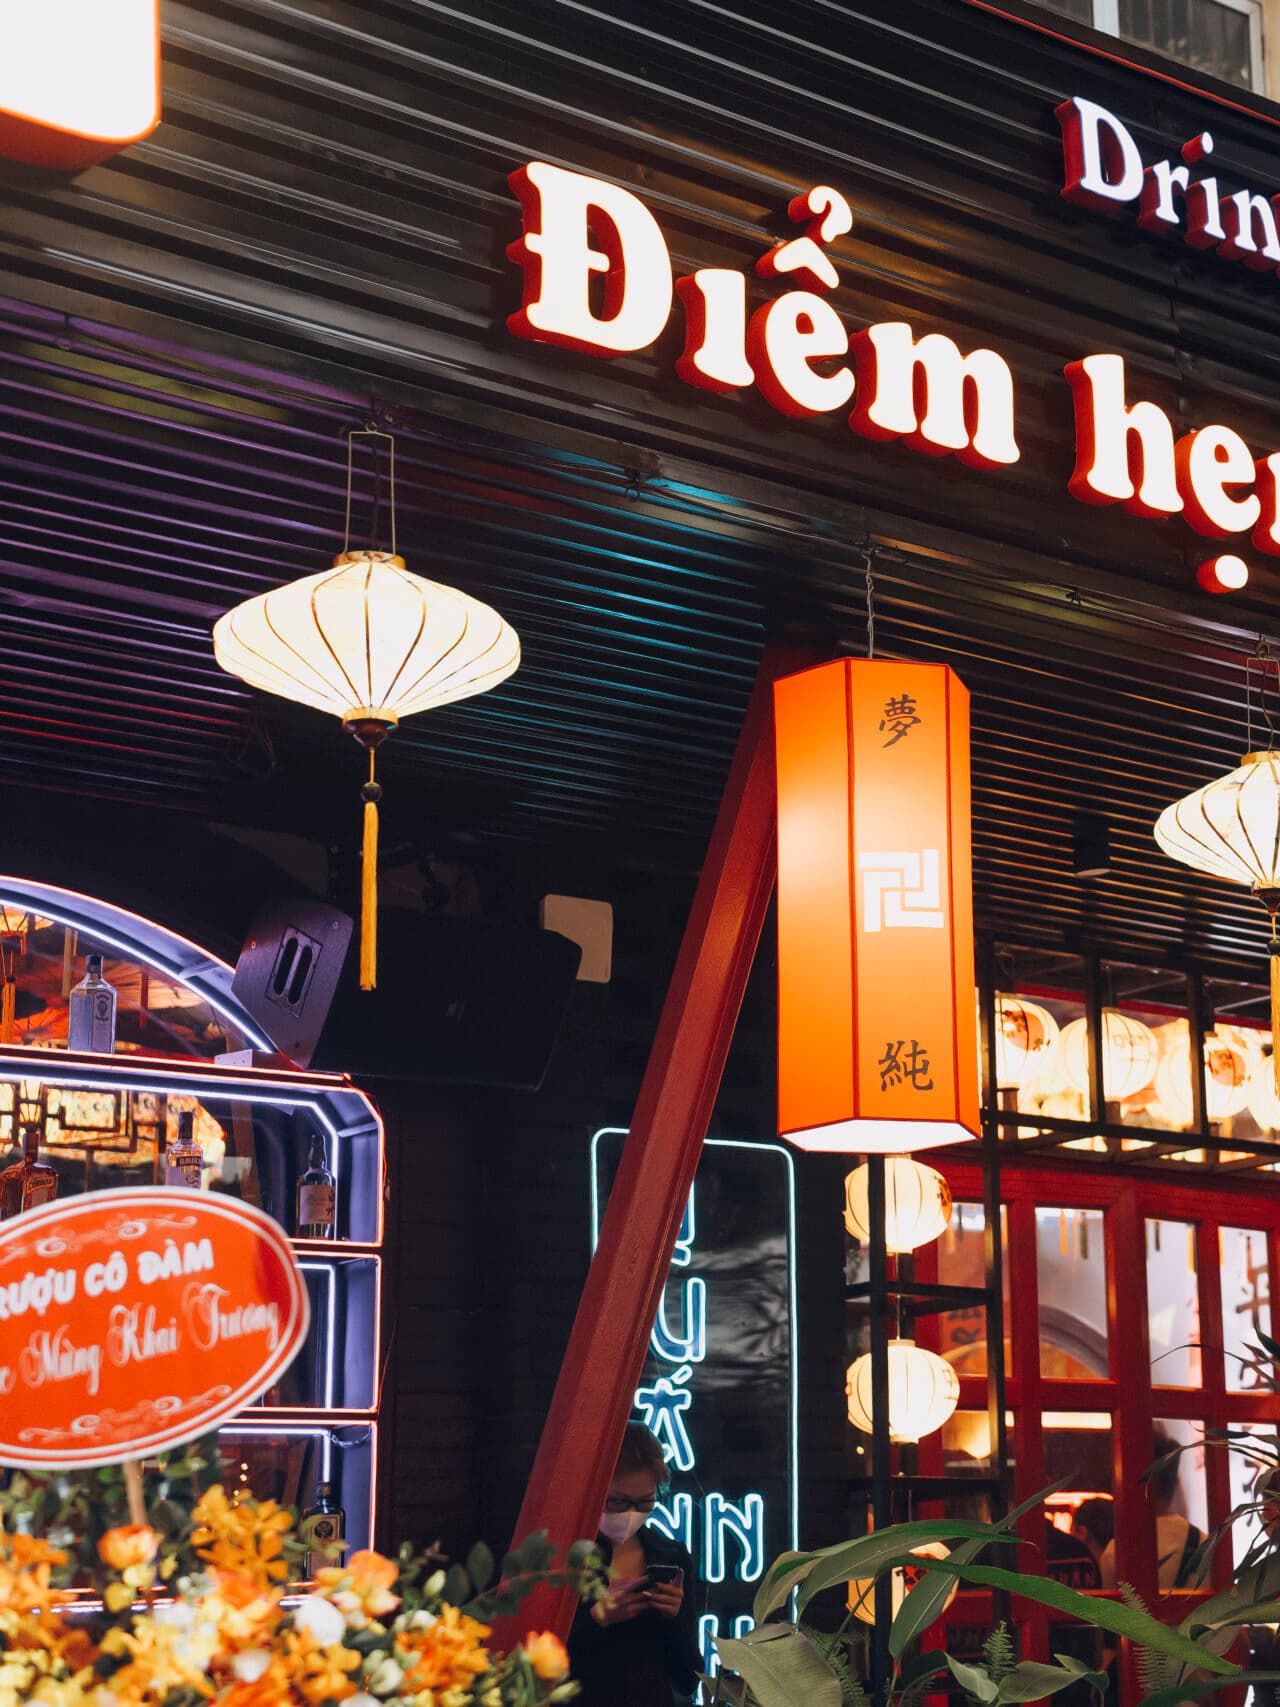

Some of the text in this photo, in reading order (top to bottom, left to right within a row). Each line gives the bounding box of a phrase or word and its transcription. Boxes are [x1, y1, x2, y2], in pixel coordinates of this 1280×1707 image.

[524, 160, 1021, 466] Điểm
[878, 693, 922, 749] 夢
[877, 1039, 935, 1093] 純
